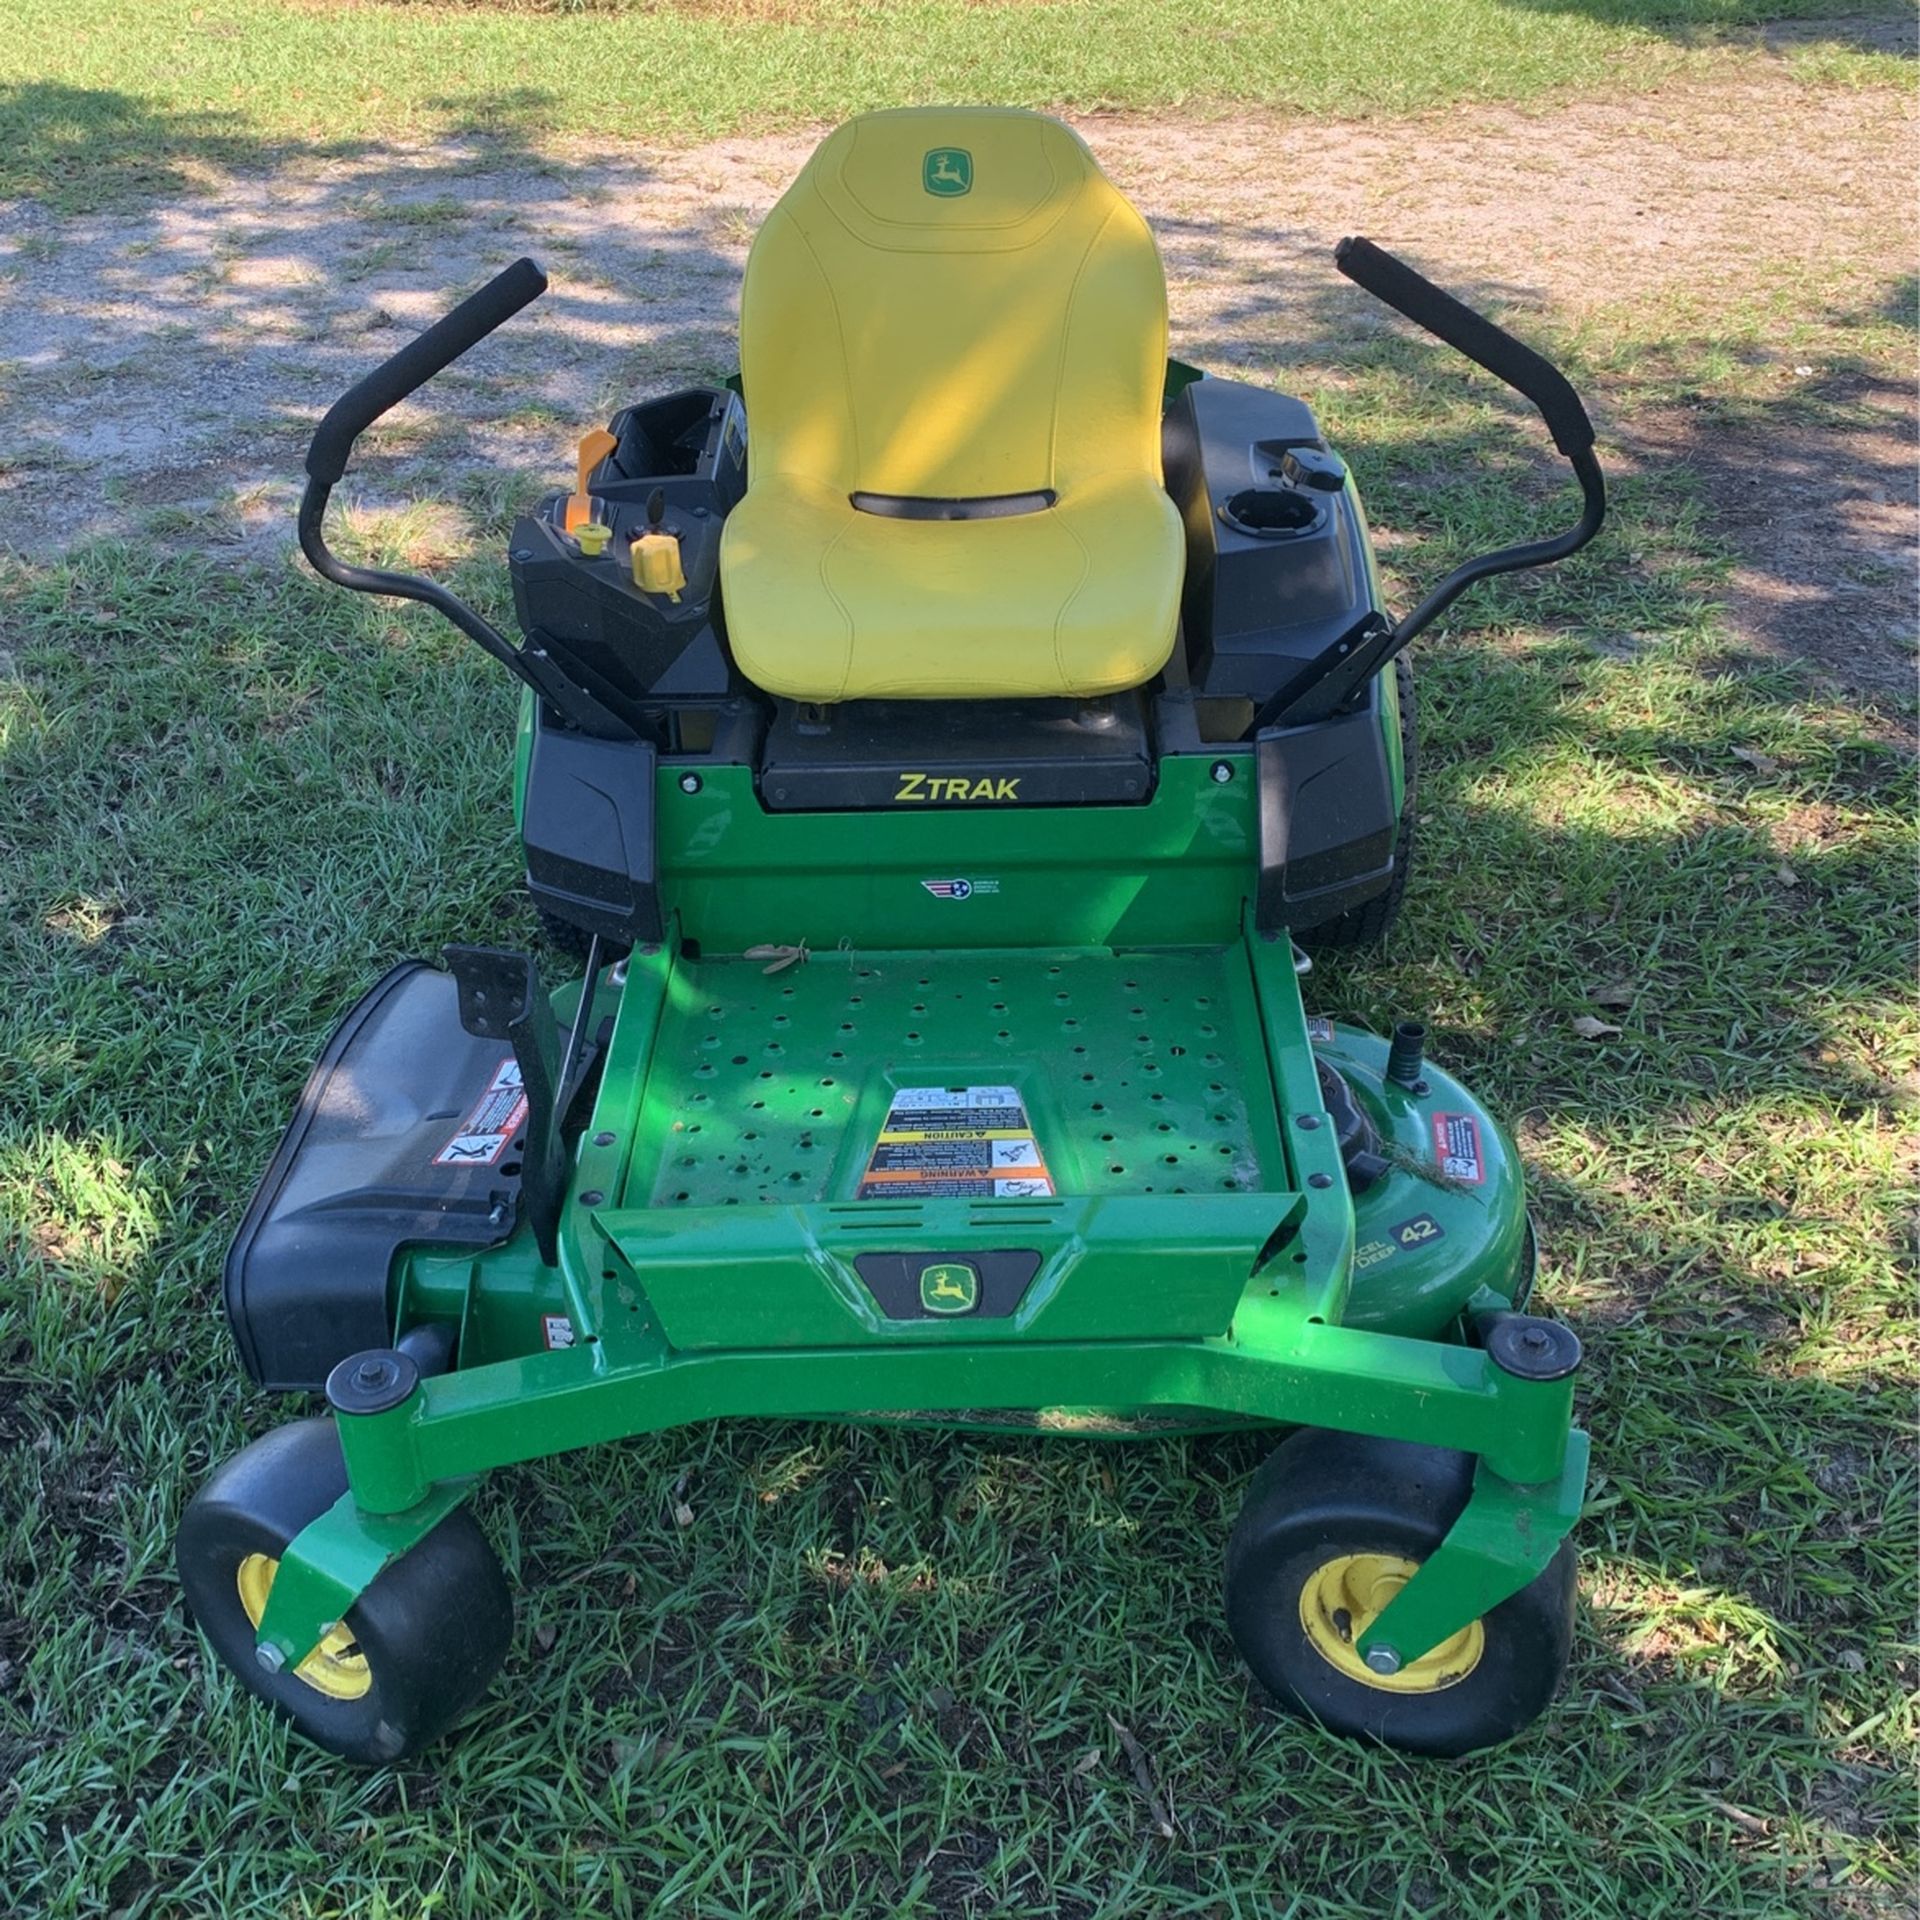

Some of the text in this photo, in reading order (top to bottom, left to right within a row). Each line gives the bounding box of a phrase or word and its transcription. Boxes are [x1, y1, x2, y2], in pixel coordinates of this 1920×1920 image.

[894, 773, 1021, 801] ZTRAK
[924, 1131, 973, 1140] CAUTION
[920, 1169, 977, 1179] WARNING
[1400, 1220, 1438, 1243] 42
[1356, 1245, 1396, 1268] DEEP
